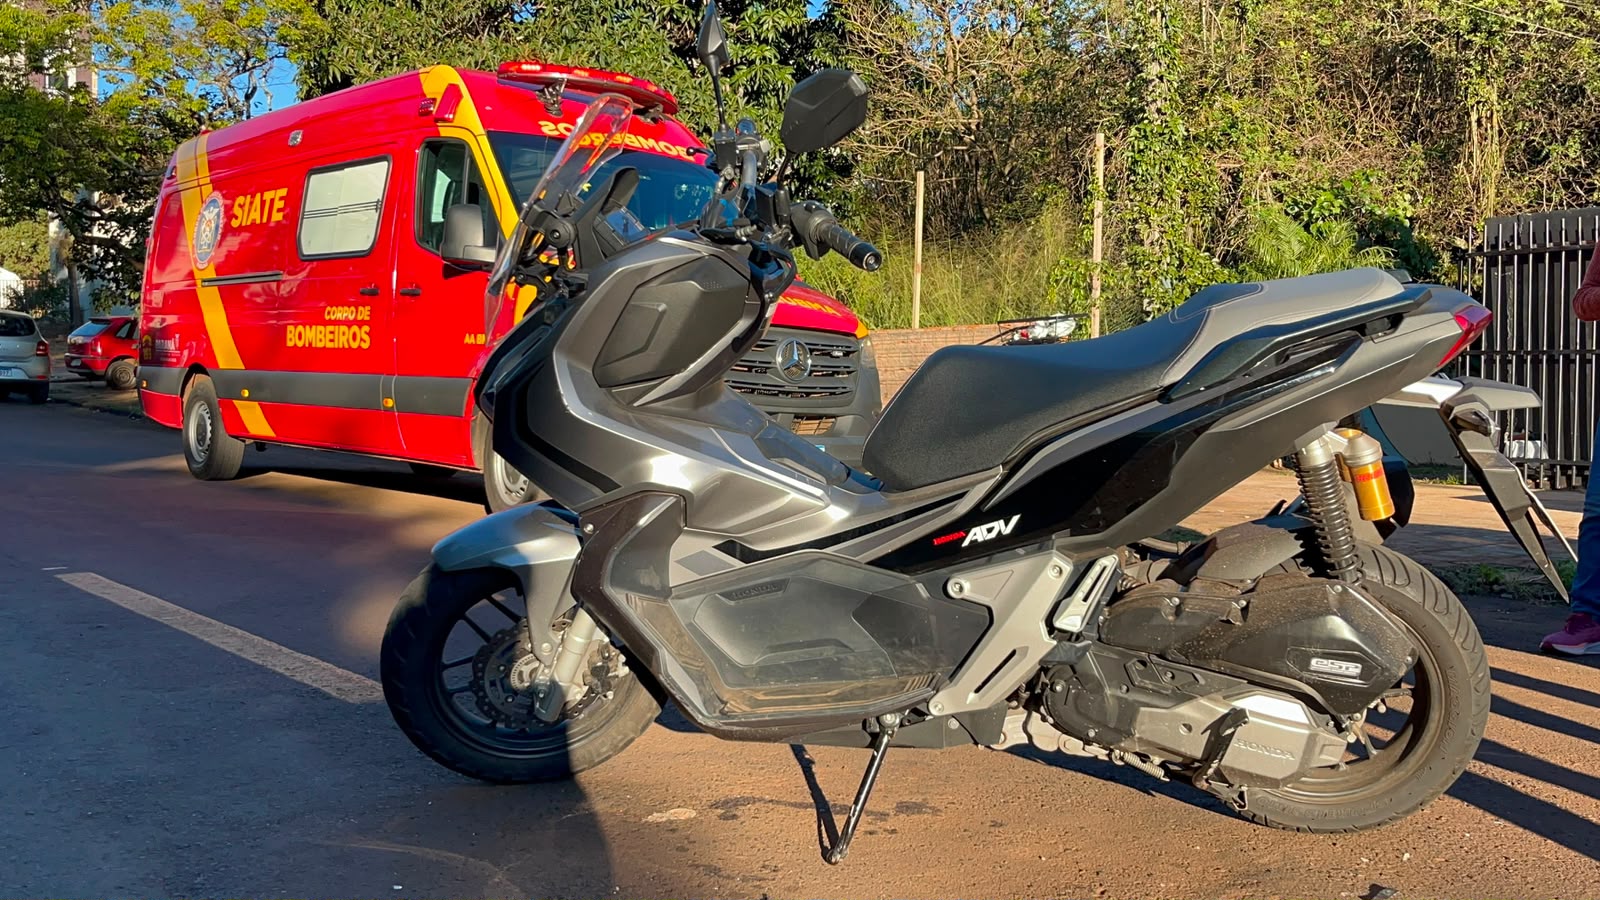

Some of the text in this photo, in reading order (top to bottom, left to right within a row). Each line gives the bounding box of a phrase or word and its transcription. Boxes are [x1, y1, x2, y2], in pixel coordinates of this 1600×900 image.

[231, 187, 288, 228] SIATE
[325, 306, 371, 320] CORPO DE
[286, 325, 371, 349] BOMBEIROS
[961, 513, 1021, 547] ADV
[1233, 738, 1296, 760] HONDA
